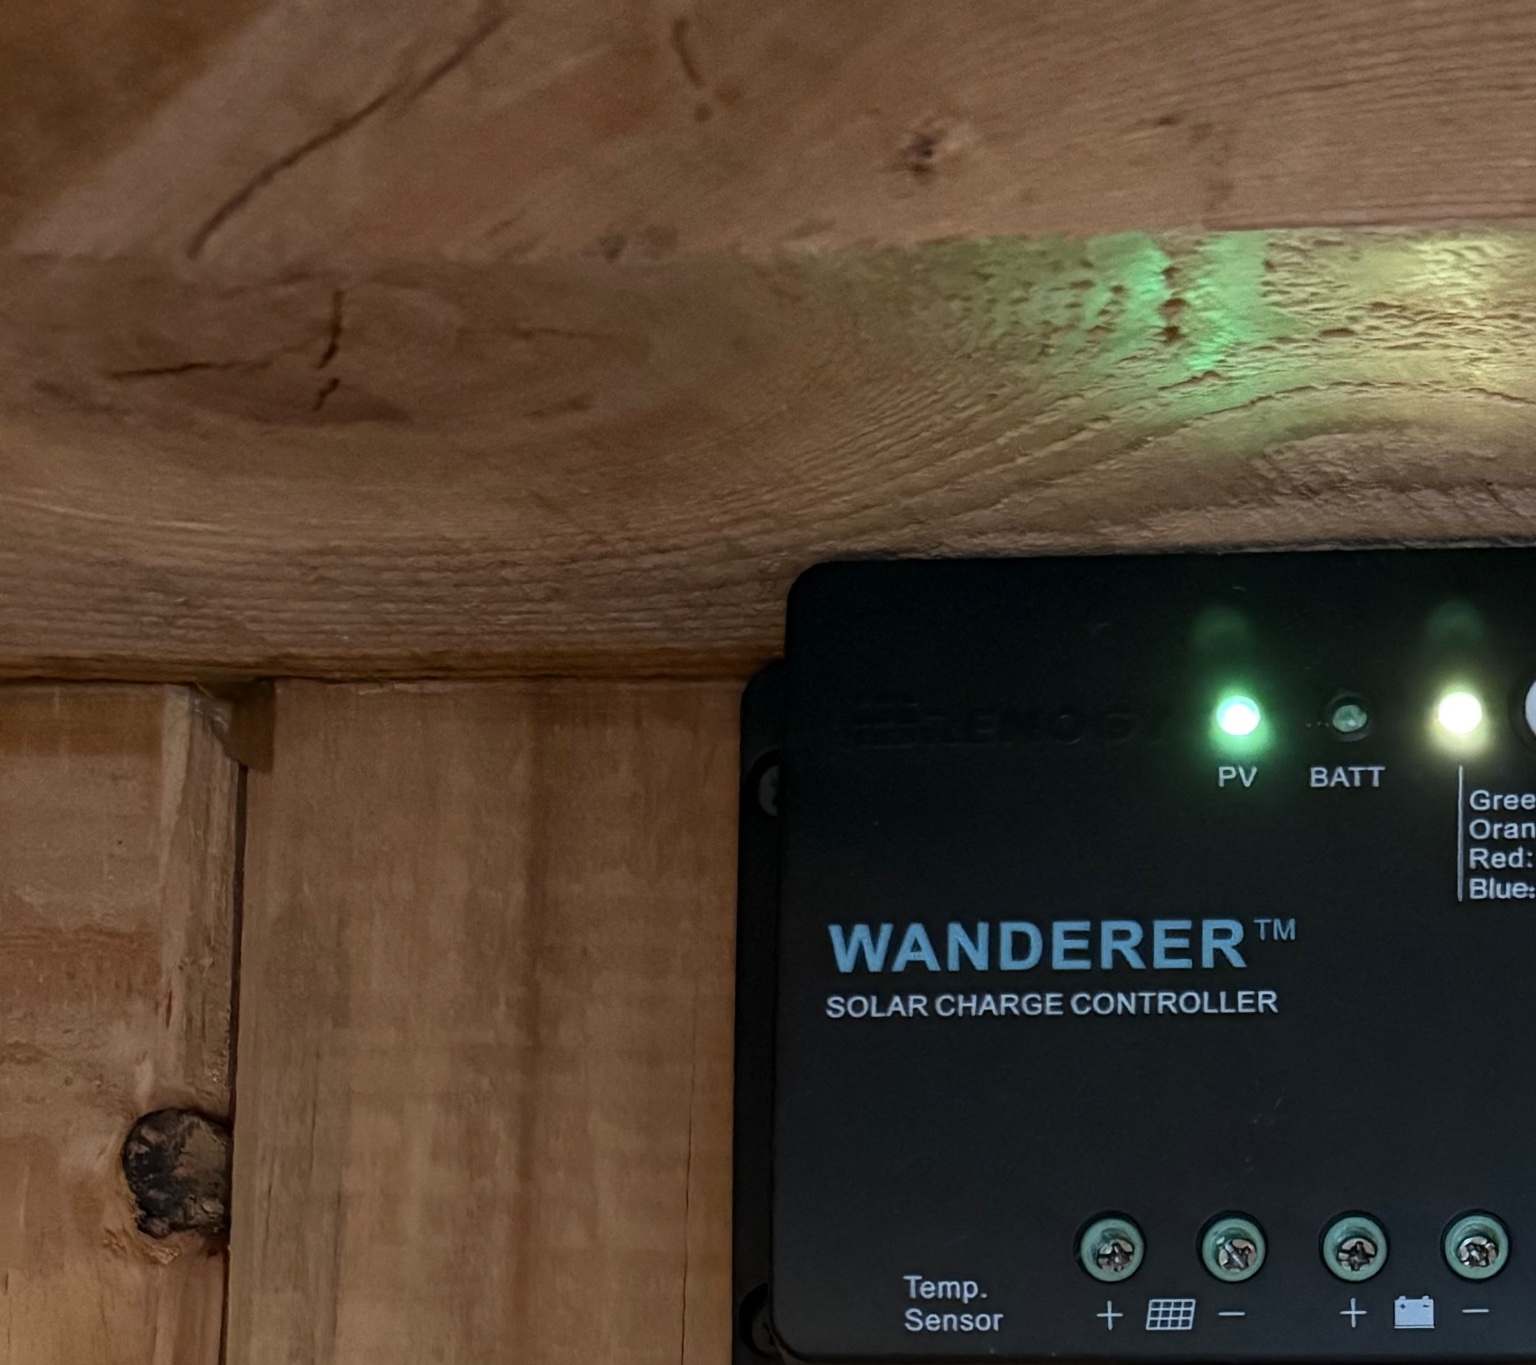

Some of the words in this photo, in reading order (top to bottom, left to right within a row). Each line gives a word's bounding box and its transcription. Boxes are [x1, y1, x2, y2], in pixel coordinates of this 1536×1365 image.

[1218, 766, 1259, 789] PV
[1310, 767, 1387, 790] BATT
[1469, 847, 1534, 870] Red:
[1469, 877, 1536, 901] Blue:
[828, 918, 1248, 974] WANDERER
[826, 995, 930, 1020] SOLAR
[935, 993, 1065, 1018] CHARGE
[1071, 990, 1280, 1017] CONTROLLER
[903, 1275, 990, 1304] Temp.
[904, 1307, 1005, 1334] Sensor
